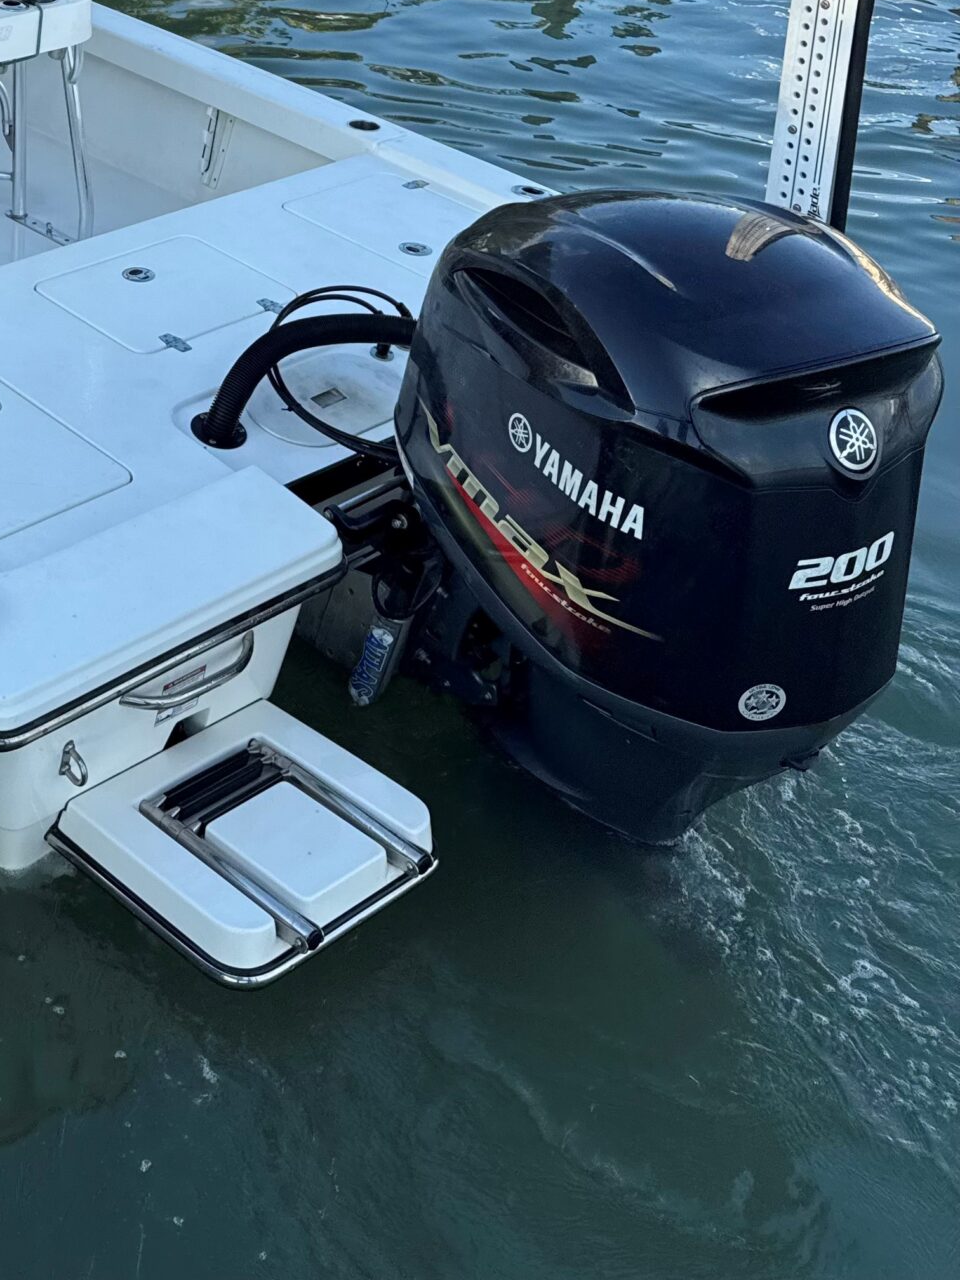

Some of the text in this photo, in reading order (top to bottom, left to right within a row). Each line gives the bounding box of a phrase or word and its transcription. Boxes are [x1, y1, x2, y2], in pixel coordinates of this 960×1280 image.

[534, 433, 645, 540] YAMAHA
[788, 531, 894, 590] 200
[809, 602, 835, 612] Super
[836, 597, 852, 607] High
